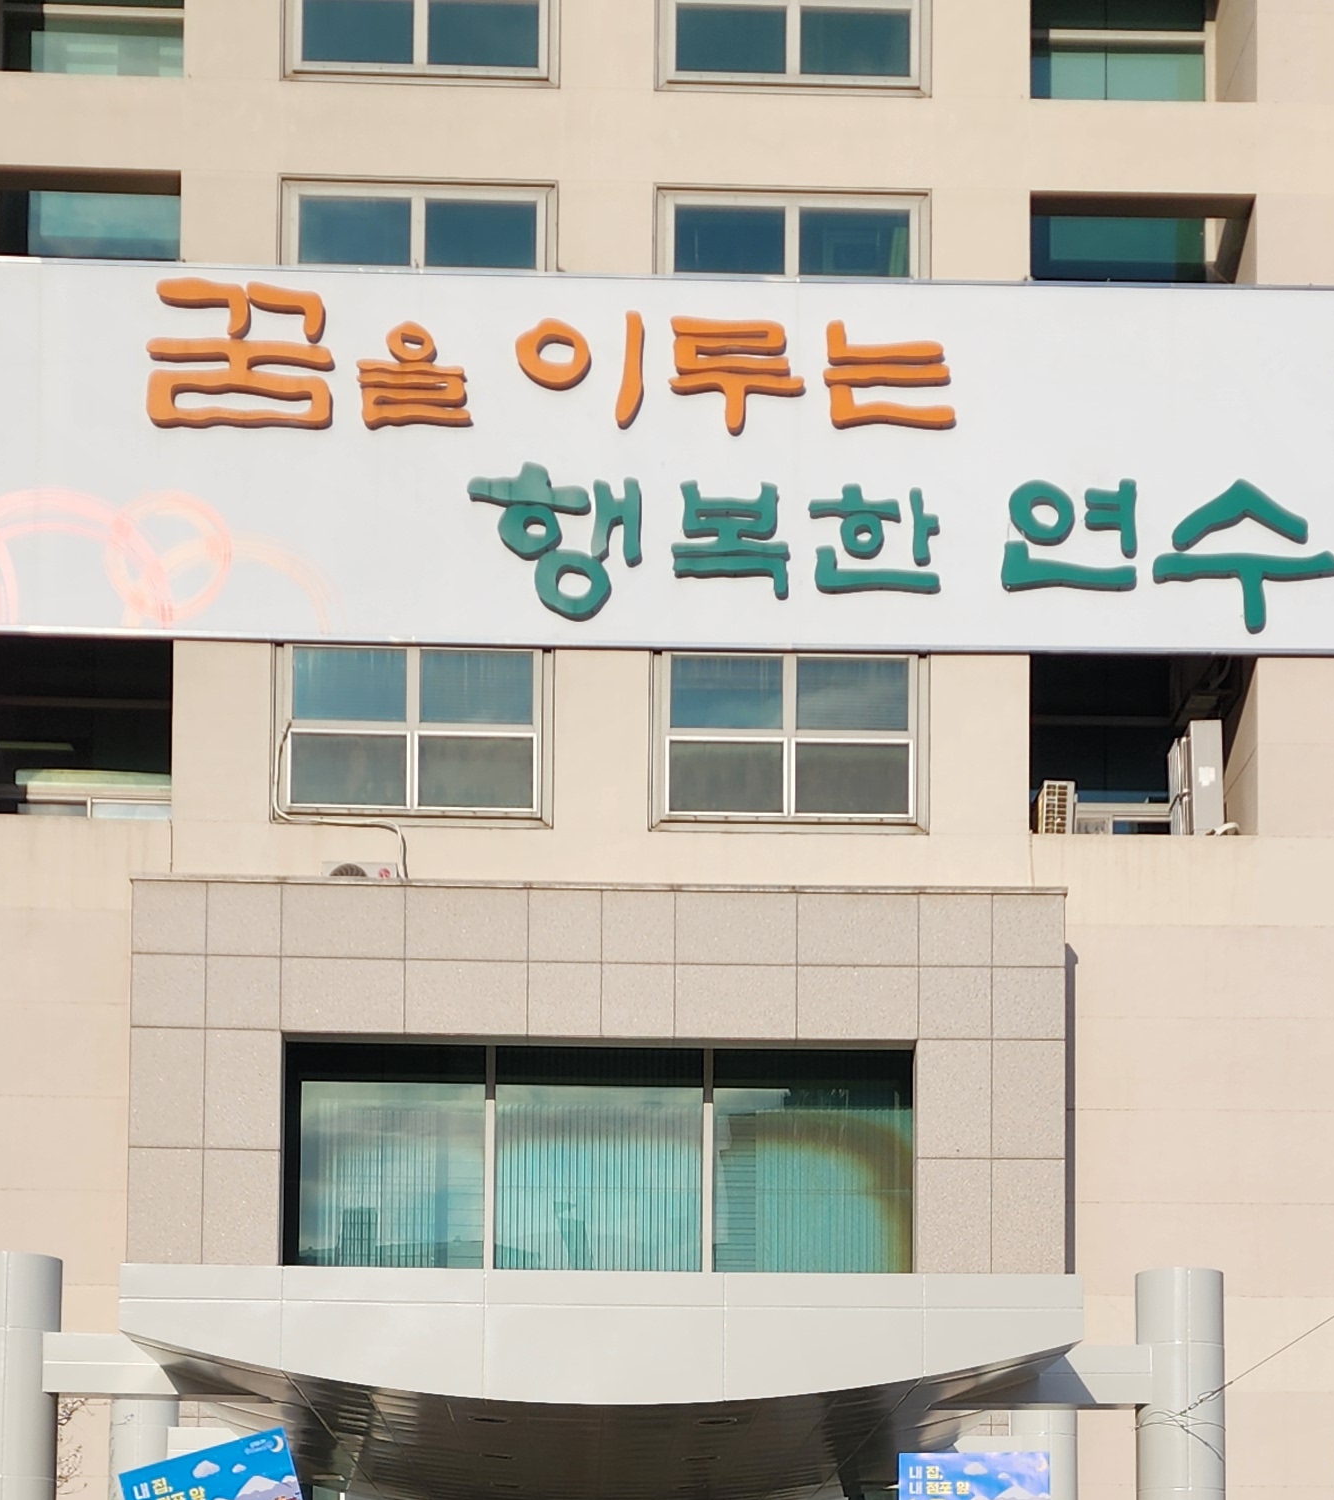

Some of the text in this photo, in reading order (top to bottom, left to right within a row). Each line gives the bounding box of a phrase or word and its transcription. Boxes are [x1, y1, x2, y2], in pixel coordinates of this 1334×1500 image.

[148, 277, 957, 435] 꿈을 이루는
[470, 461, 940, 620] 행복한
[132, 1475, 173, 1500] 내 집,
[909, 1465, 943, 1479] 내 집,
